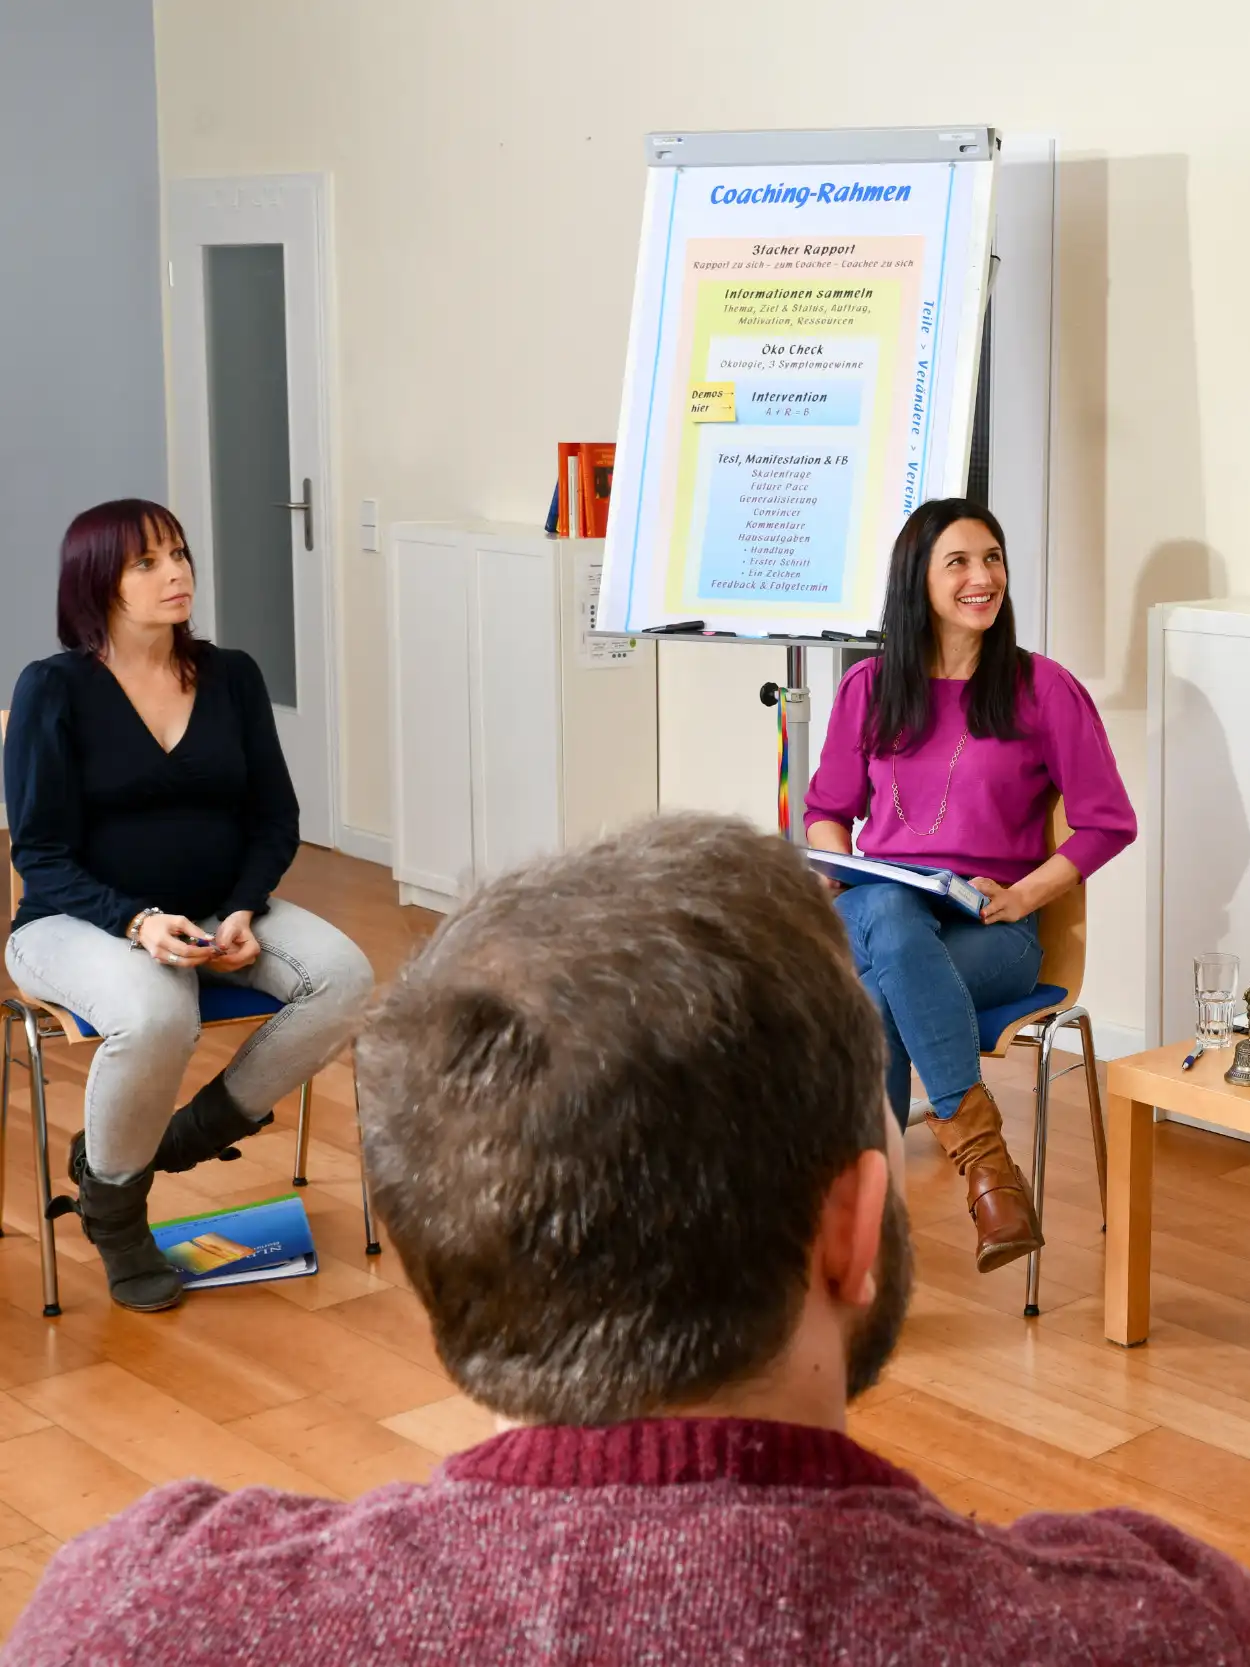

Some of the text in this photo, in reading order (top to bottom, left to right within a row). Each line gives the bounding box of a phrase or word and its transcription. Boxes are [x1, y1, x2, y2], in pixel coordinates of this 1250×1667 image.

[710, 182, 912, 208] Coaching-Rahmen
[752, 243, 856, 257] 3facher Rapport
[693, 261, 729, 270] Rapport
[731, 261, 743, 269] zu
[745, 260, 765, 269] sich
[774, 261, 793, 269] zum
[795, 260, 832, 269] Coachee
[841, 260, 879, 269] Coachee
[880, 260, 893, 268] zu
[894, 259, 914, 268] sich
[724, 288, 873, 299] Informationen sammeln
[723, 303, 871, 314] Thema, Ziel & Status, Auftrag,
[738, 316, 854, 326] Motivation, Ressourcen
[921, 300, 935, 333] Teile
[761, 344, 824, 355] Öko Check
[769, 360, 775, 369] 3
[778, 360, 864, 371] Symptomgewinne
[691, 390, 723, 399] Demos
[751, 391, 828, 403] Intervention
[912, 360, 929, 435] Verändere
[691, 404, 710, 413] hier
[766, 408, 772, 416] A
[784, 408, 791, 416] R
[718, 453, 849, 466] Test, Manifestation & FB
[751, 469, 812, 480] Skalenfrage
[751, 481, 809, 491] Future Pace
[739, 494, 818, 506] Generalisierung
[753, 508, 801, 517] Convincer
[745, 520, 806, 530] Kommentare
[738, 533, 811, 544] Hausaufgaben
[750, 546, 795, 556] Handlung
[750, 557, 811, 567] Erster Schritt
[748, 569, 801, 578] Ein Zeichen
[711, 579, 828, 592] Feedback & Folgetermin
